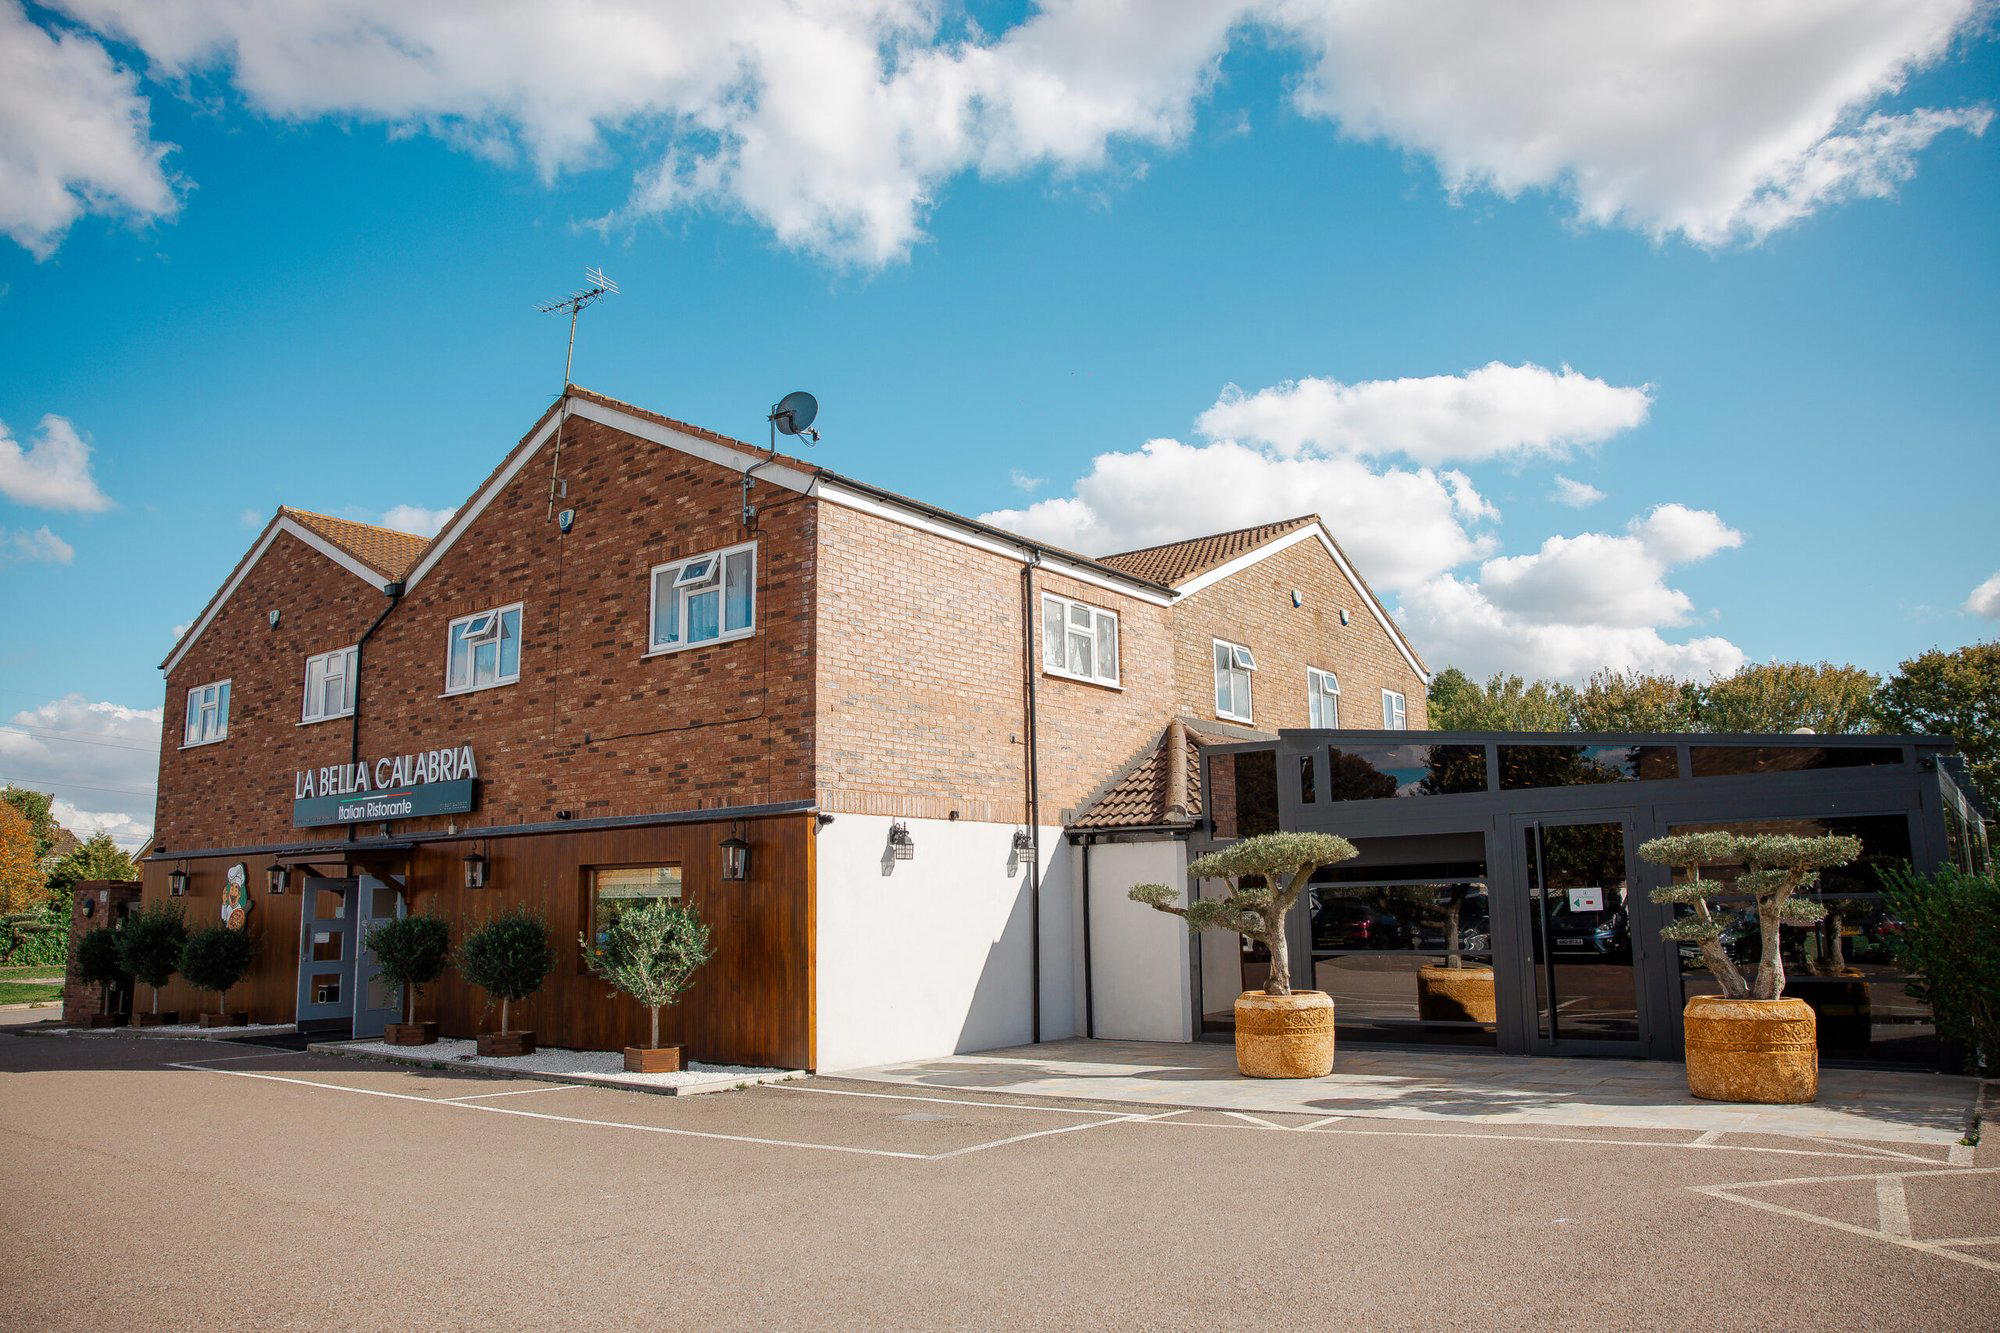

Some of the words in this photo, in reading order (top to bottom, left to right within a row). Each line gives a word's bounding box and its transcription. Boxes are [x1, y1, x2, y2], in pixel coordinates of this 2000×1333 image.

[295, 770, 315, 799] LA
[320, 761, 369, 796] BELLA
[375, 746, 475, 789] CALABRIA
[338, 805, 365, 820] Italian
[366, 799, 412, 818] Ristorante
